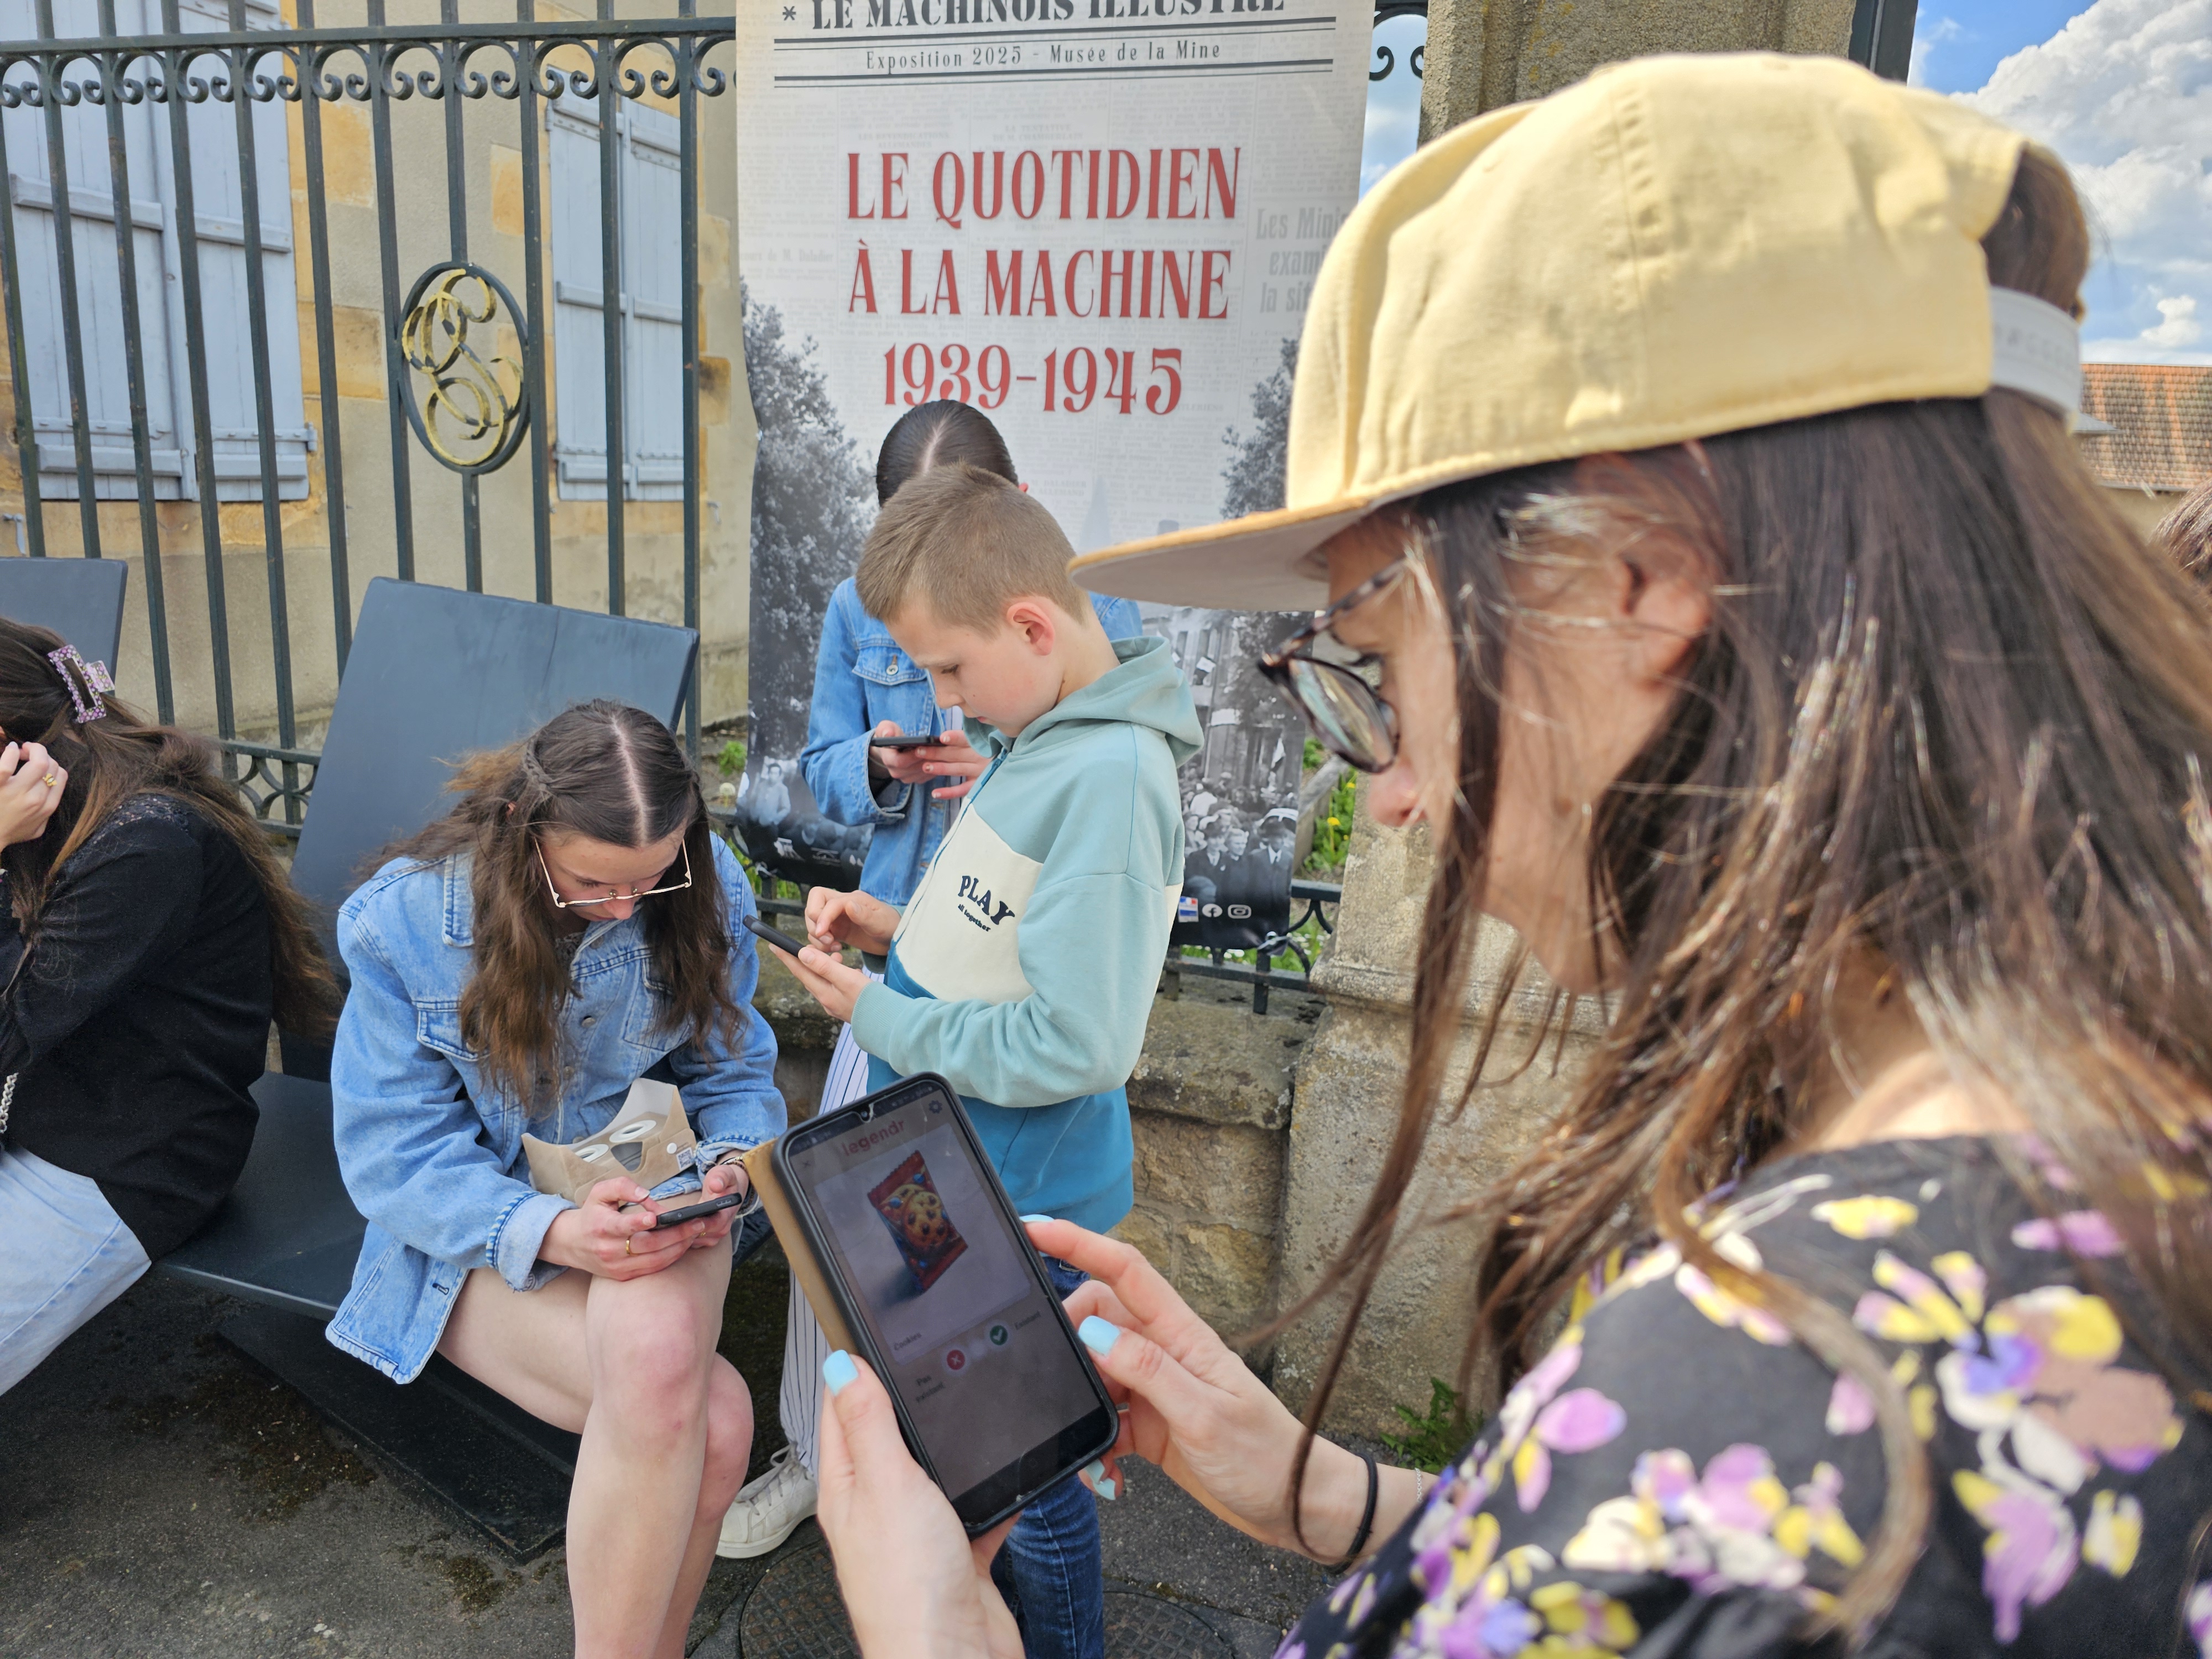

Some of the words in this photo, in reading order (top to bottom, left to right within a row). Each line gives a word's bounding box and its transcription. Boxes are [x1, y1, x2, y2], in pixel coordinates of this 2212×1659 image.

[812, 0, 853, 29] LE
[866, 0, 1073, 27] MACHINOIS
[867, 51, 962, 73] Exposition
[972, 45, 1021, 65] 2025
[1050, 45, 1106, 62] Musée
[1117, 43, 1138, 61] de
[1149, 41, 1165, 60] la
[1177, 40, 1220, 59] Mine
[848, 153, 909, 219] LE
[932, 147, 1241, 229] QUOTIDIEN
[848, 238, 878, 314] À
[901, 249, 962, 315] LA
[984, 249, 1232, 319] MACHINE
[884, 342, 1182, 415] 1939-1945
[957, 875, 1015, 925] PLAY
[964, 909, 991, 932] together
[841, 1119, 905, 1156] legendr
